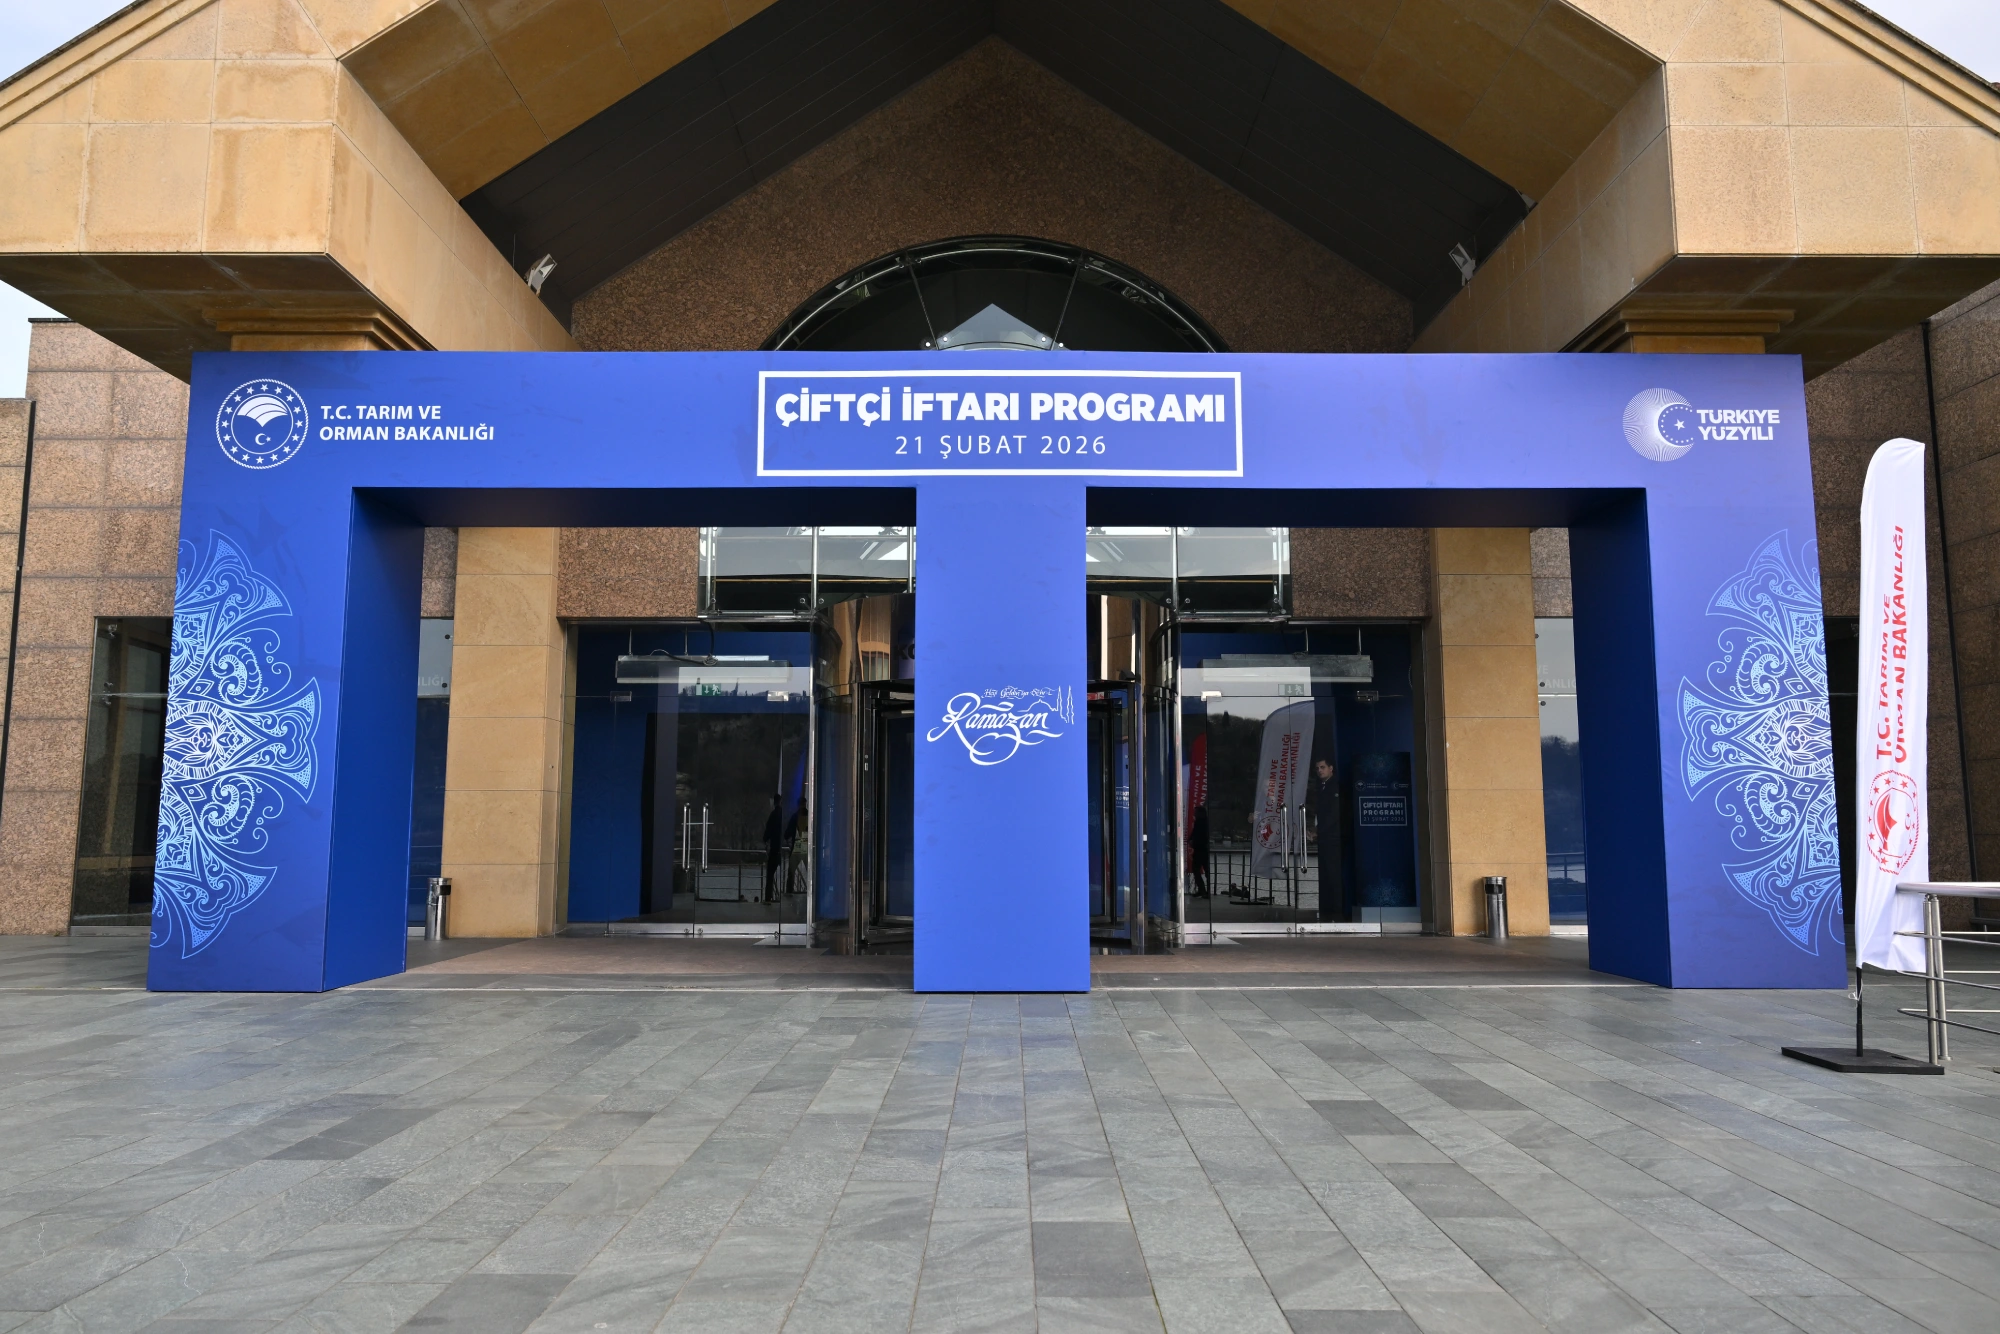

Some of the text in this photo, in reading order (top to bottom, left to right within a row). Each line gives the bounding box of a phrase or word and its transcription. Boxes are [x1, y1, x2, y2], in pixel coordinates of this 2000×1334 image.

[320, 405, 441, 420] T.C. TARIM VE
[775, 386, 1225, 427] ÇİFTÇİ İFTARI PROGRAMI
[319, 422, 494, 441] ORMAN BAKANLIĞI
[895, 435, 1107, 460] 21 ŞUBAT 2026
[1892, 525, 1907, 660] BAKANLIĞI
[1876, 593, 1892, 760] T.C. TARIM VE
[927, 692, 1063, 766] Ramazan
[1271, 759, 1279, 770] VE
[1279, 734, 1291, 780] BAKANLIĞI
[1267, 771, 1277, 797] TARIM
